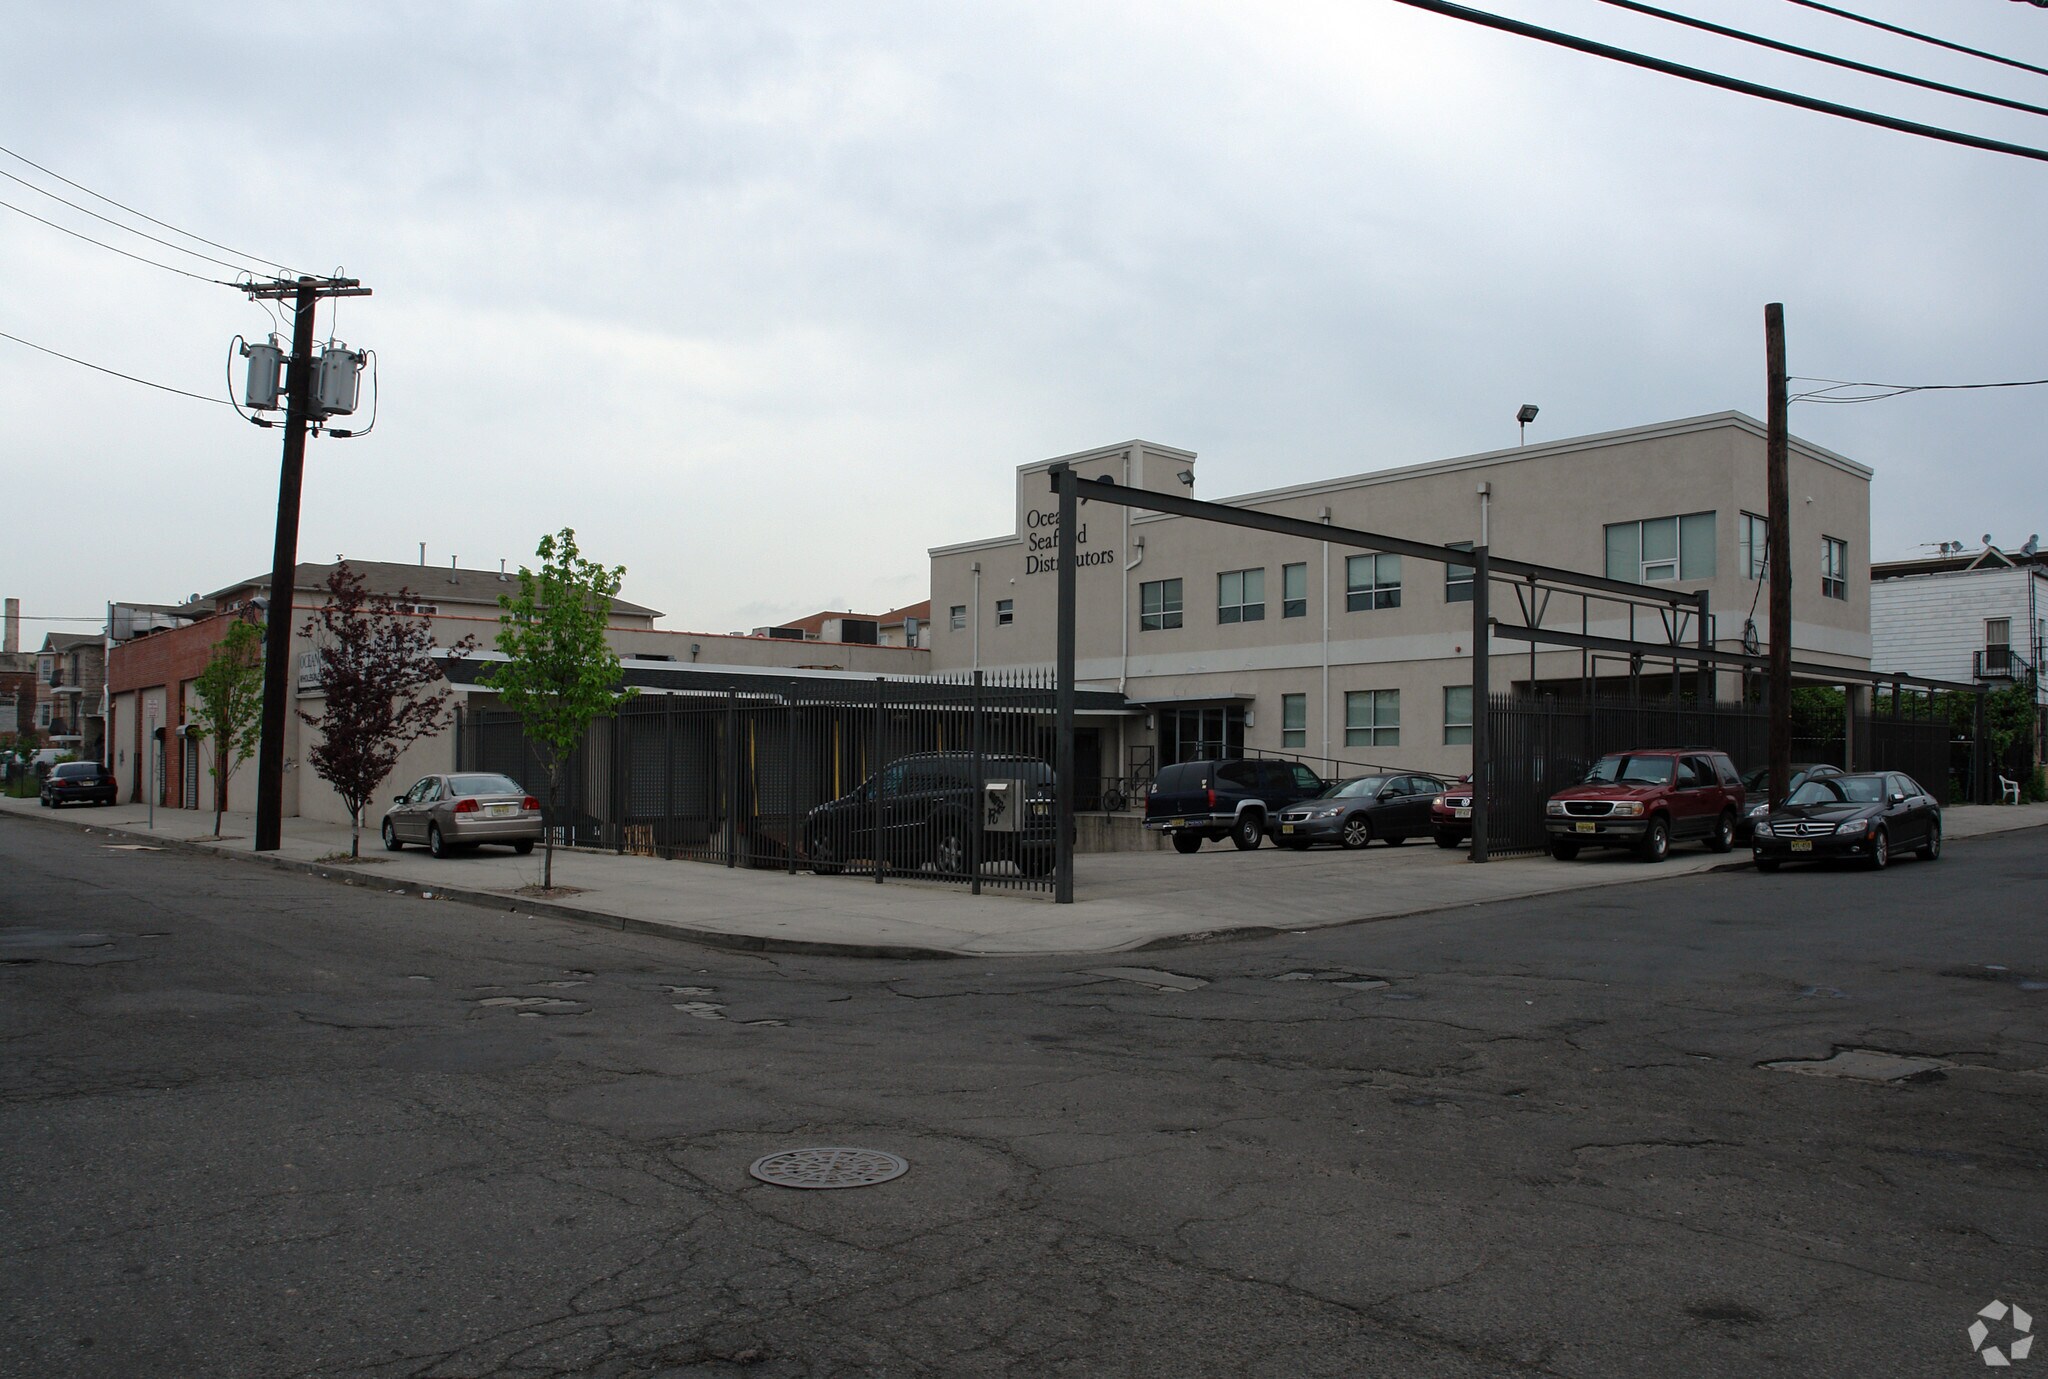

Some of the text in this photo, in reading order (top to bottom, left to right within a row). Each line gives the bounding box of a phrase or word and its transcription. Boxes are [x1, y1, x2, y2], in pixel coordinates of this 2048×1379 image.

[1027, 509, 1060, 529] Ocea
[1029, 523, 1087, 551] Seafd
[1026, 549, 1114, 575] Distutors
